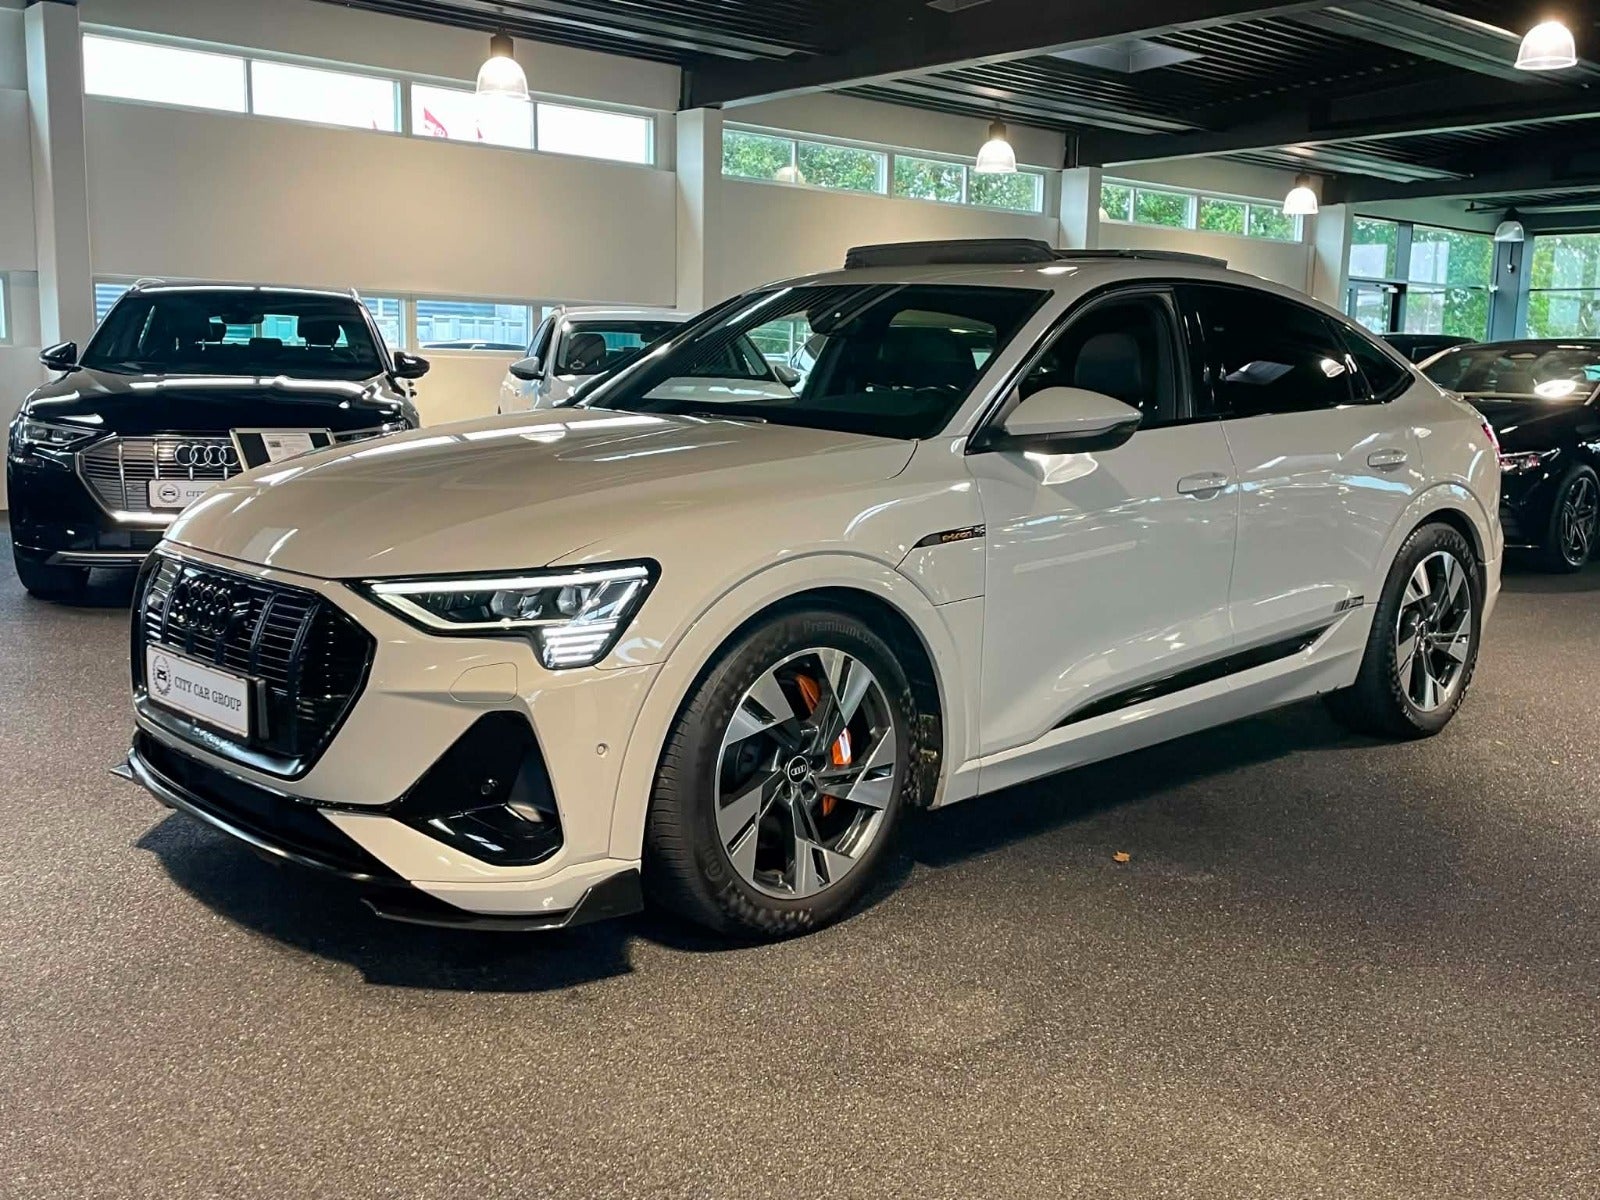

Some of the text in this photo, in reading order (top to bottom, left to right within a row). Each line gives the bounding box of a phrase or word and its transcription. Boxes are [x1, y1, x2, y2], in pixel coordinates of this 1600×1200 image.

[175, 676, 242, 711] CITY CAR GROUP
